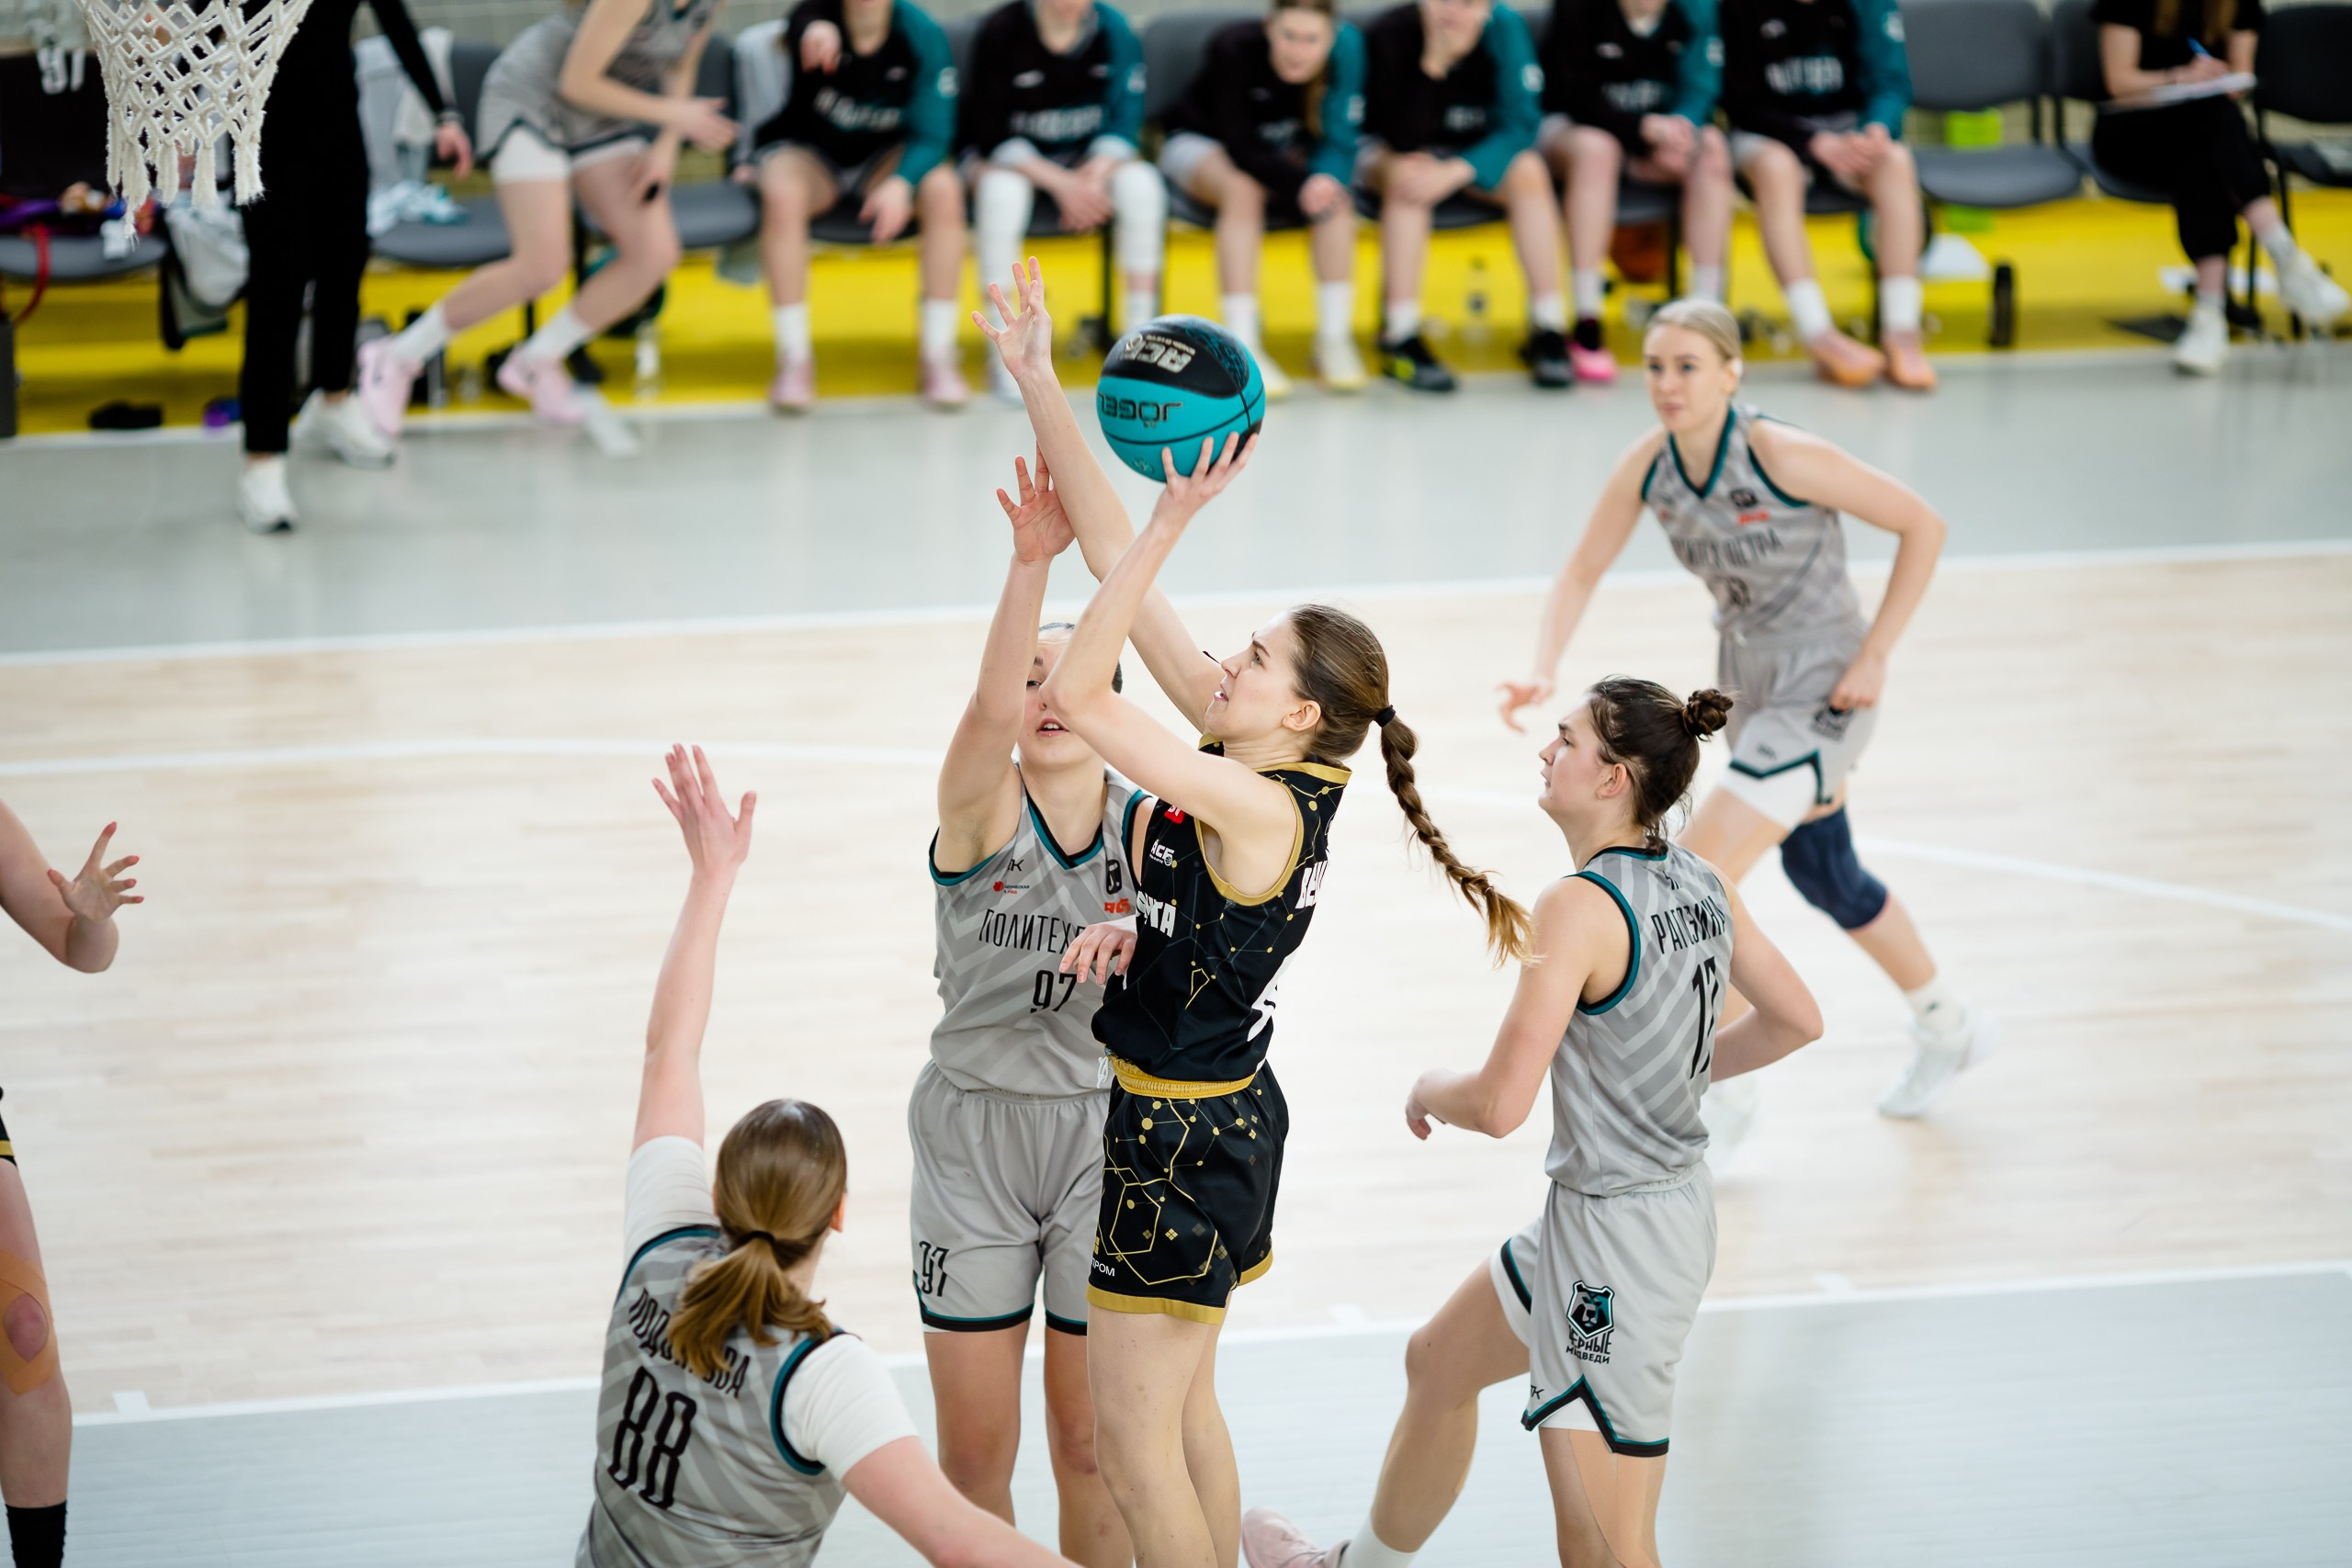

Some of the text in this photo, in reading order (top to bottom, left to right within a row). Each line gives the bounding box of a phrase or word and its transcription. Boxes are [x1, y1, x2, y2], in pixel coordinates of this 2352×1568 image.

[978, 908, 1072, 955] ПОЛИТЕХ
[1029, 969, 1078, 1014] 97
[919, 1240, 950, 1297] 97
[606, 1365, 697, 1510] 88
